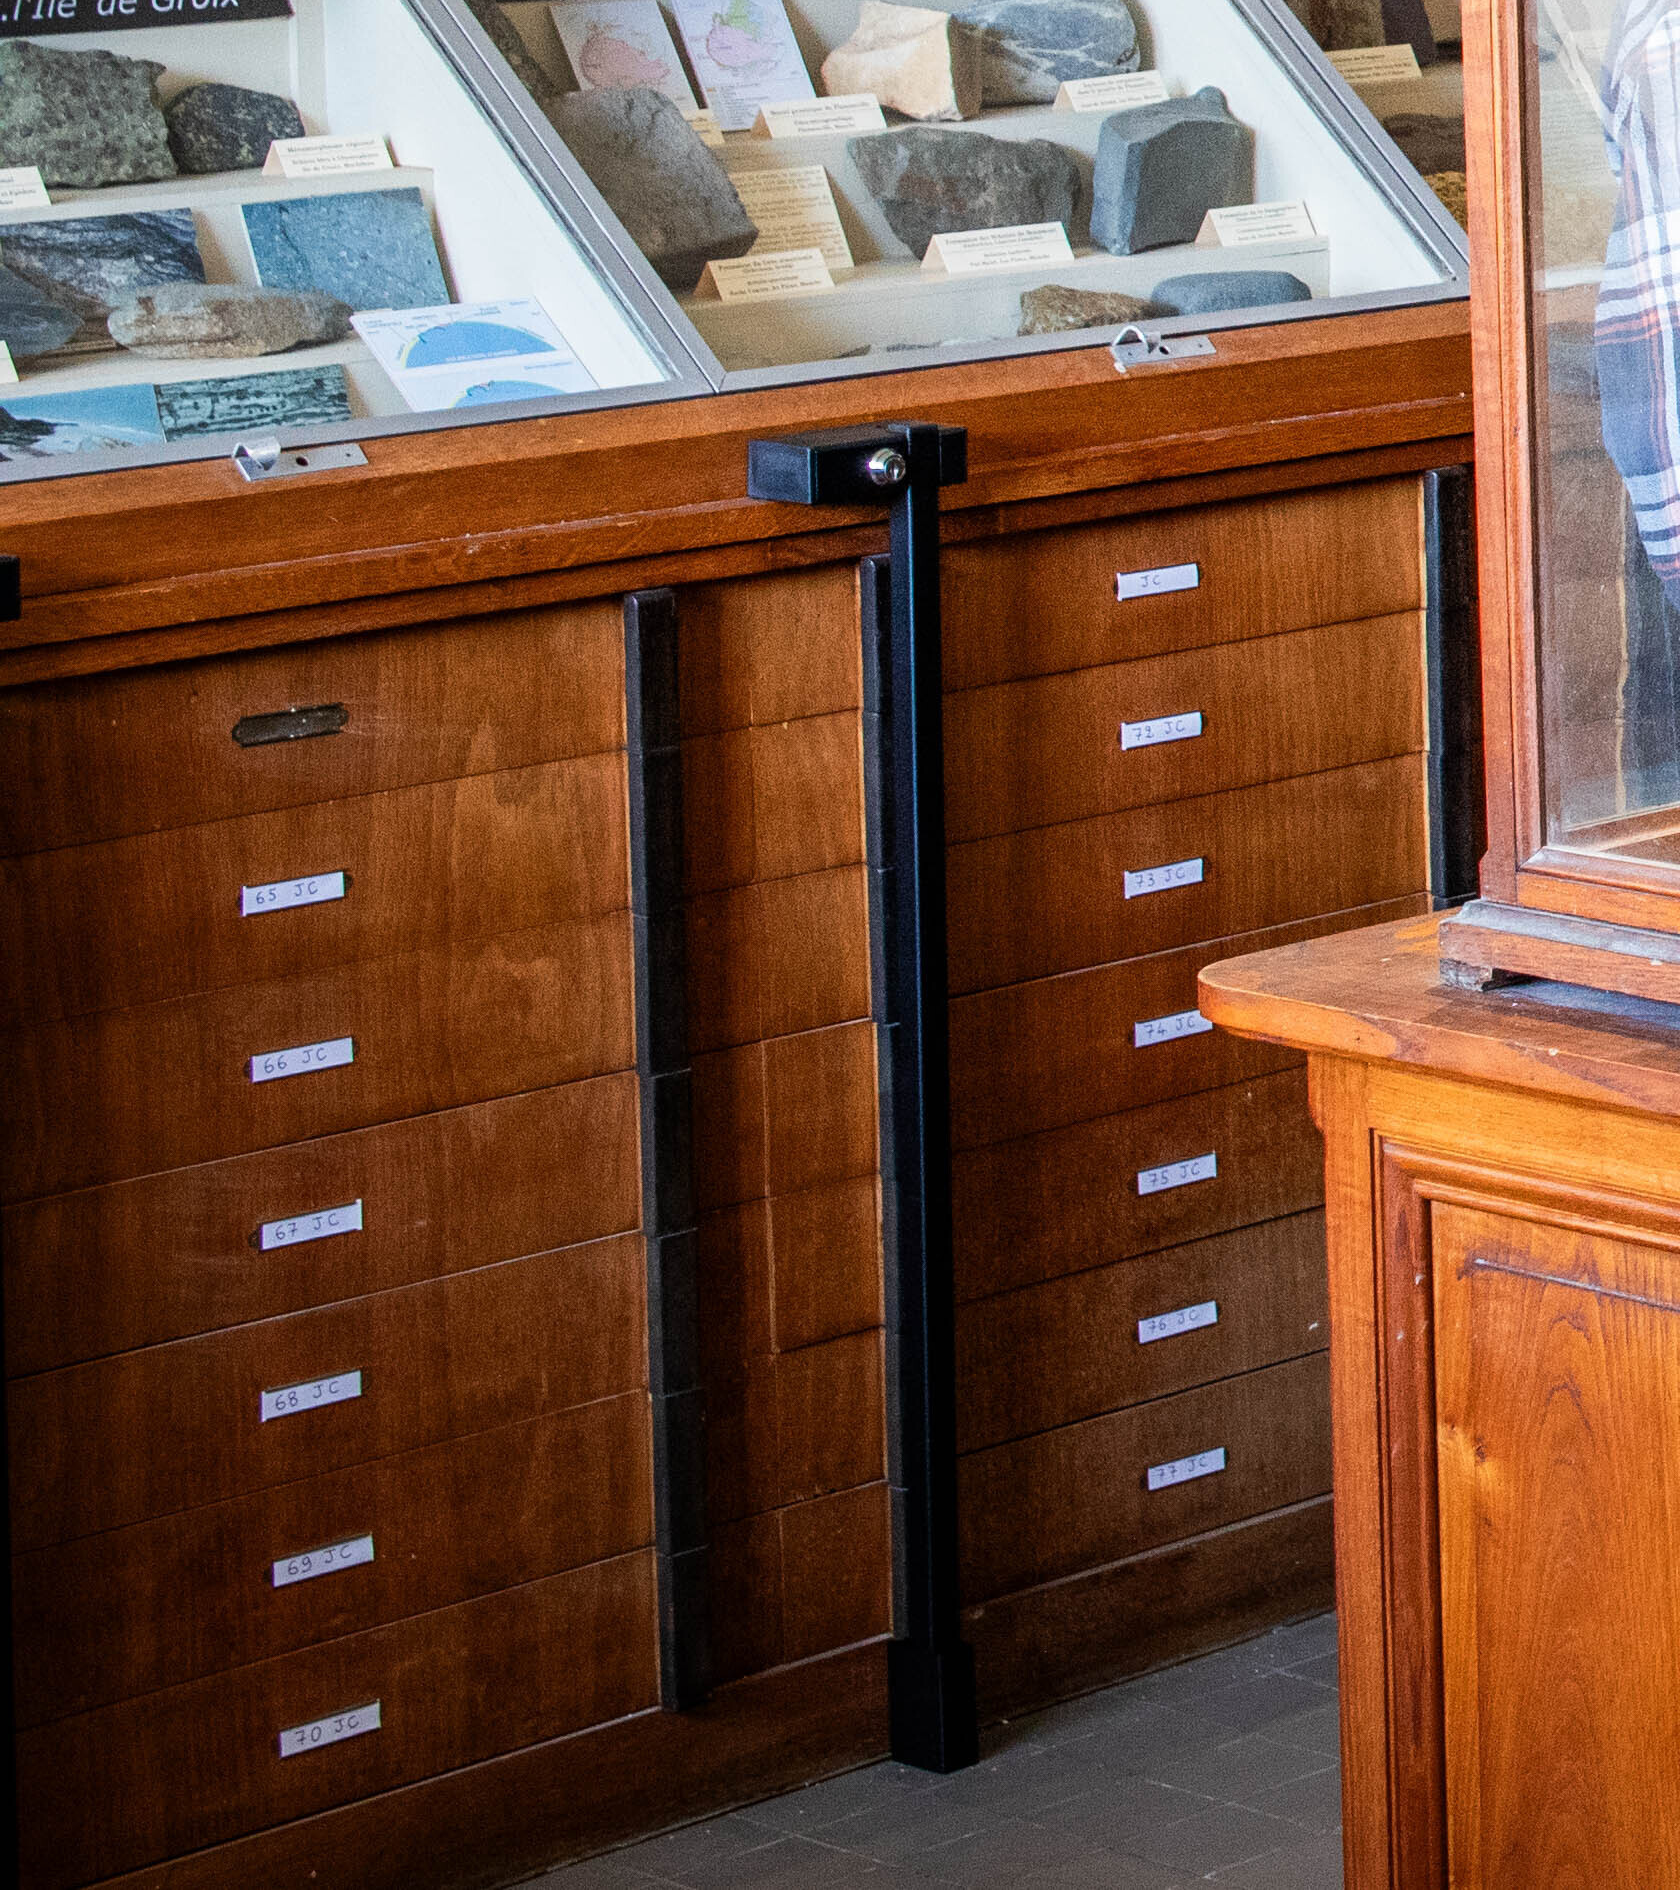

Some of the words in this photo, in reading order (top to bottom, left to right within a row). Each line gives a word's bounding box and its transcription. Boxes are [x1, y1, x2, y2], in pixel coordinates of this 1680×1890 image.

[1140, 574, 1161, 588] JC
[1164, 720, 1185, 735] JC
[1134, 873, 1156, 888] 73
[1164, 867, 1186, 882] JC
[255, 888, 277, 905] 65
[294, 881, 319, 897] JC
[1144, 1022, 1166, 1036] 74
[1176, 1014, 1196, 1031] JC
[264, 1055, 287, 1073] 66
[301, 1047, 327, 1064] JC
[1149, 1171, 1169, 1187] 75
[1180, 1161, 1201, 1179] JC
[275, 1222, 298, 1241] 67
[311, 1212, 340, 1231] JC
[1177, 1308, 1199, 1325] JC
[275, 1390, 298, 1411] 68
[312, 1380, 339, 1399] JC
[288, 1556, 312, 1575] 69
[322, 1544, 350, 1564] JC
[295, 1725, 321, 1745] 70
[333, 1714, 359, 1733] JC
